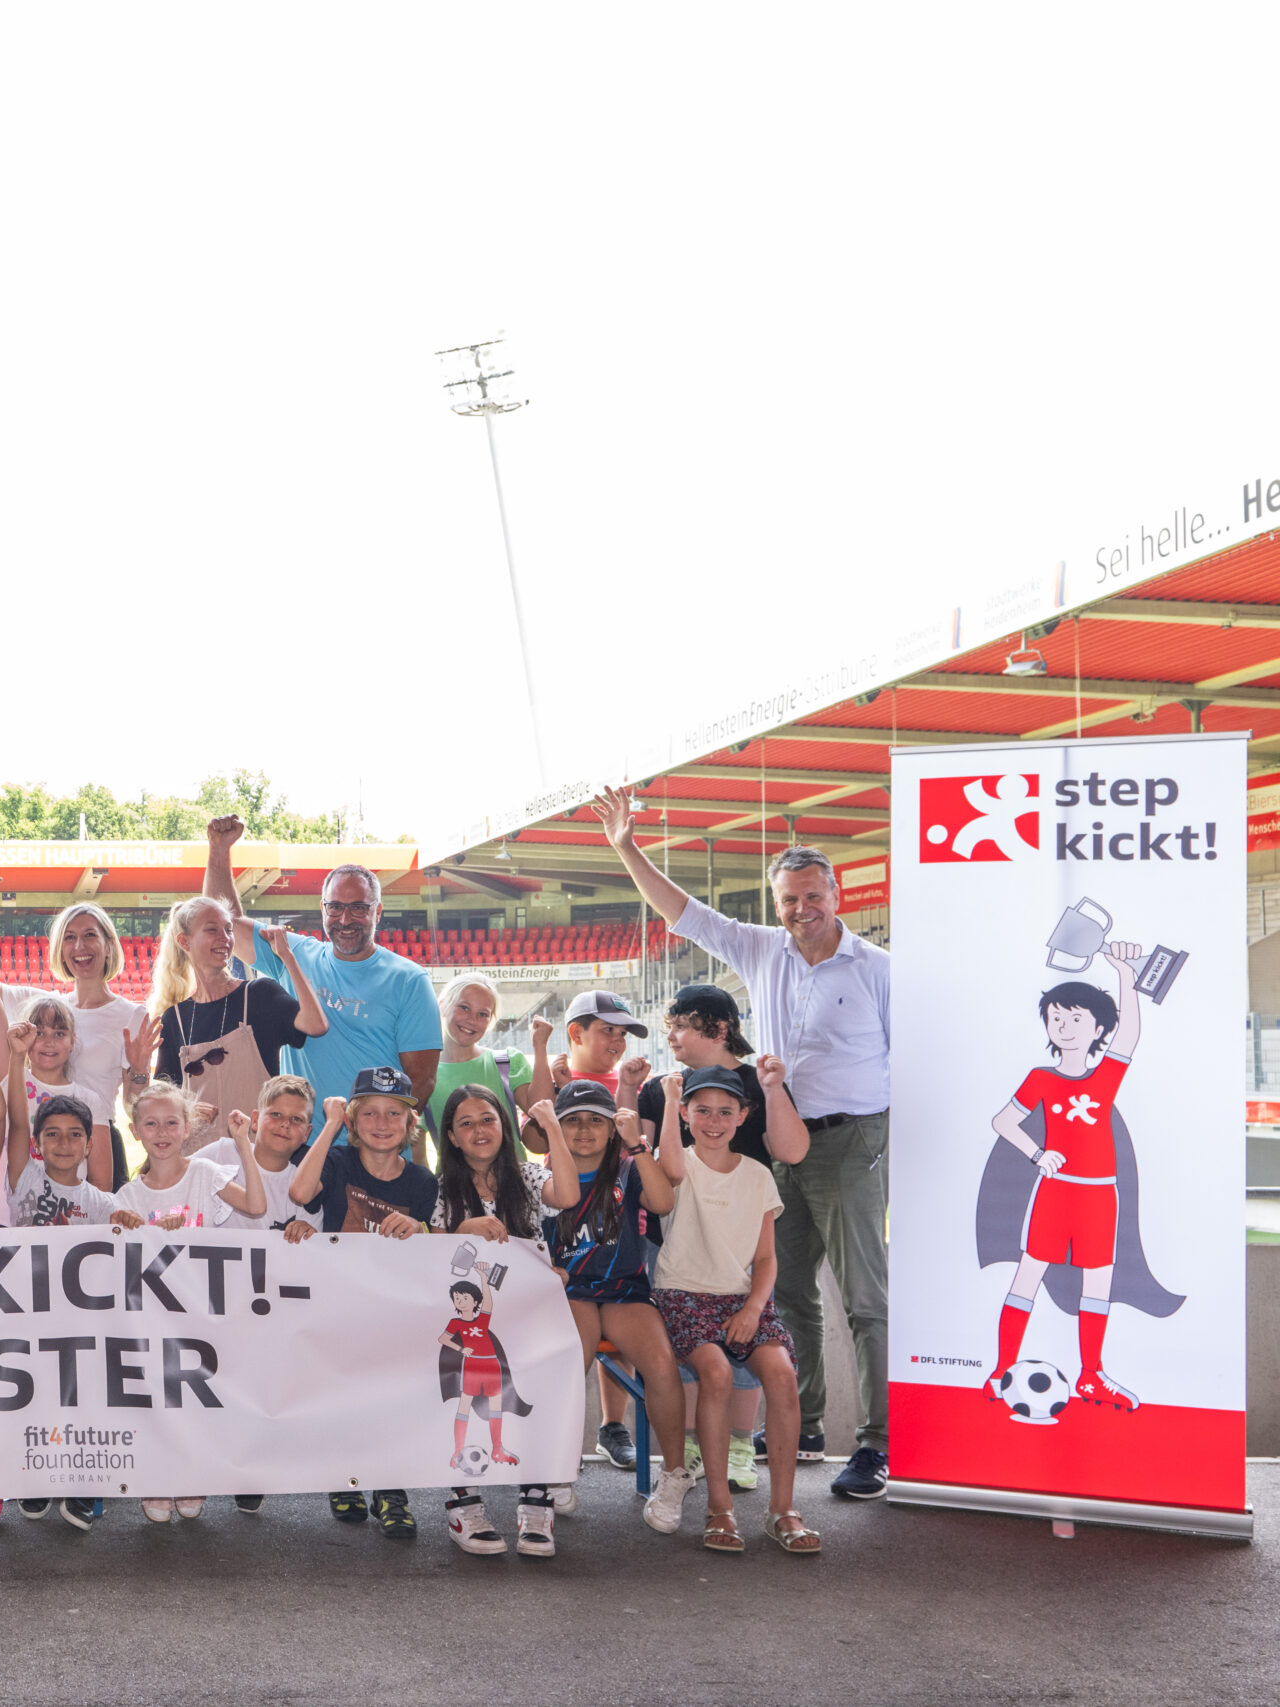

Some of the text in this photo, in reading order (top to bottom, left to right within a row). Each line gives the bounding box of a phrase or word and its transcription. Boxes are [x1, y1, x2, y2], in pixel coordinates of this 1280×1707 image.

[1096, 533, 1130, 584] Sei
[1055, 772, 1179, 816] step
[1248, 792, 1280, 811] Biers
[1056, 821, 1218, 861] kickt!
[45, 845, 183, 865] HAUPTTRIBÜNE
[454, 965, 560, 981] HnsteinEnergie
[1146, 973, 1157, 987] step
[920, 1356, 983, 1368] DFL STIFTUNG
[24, 1424, 134, 1447] fit4future
[49, 1474, 112, 1483] GERMANY
